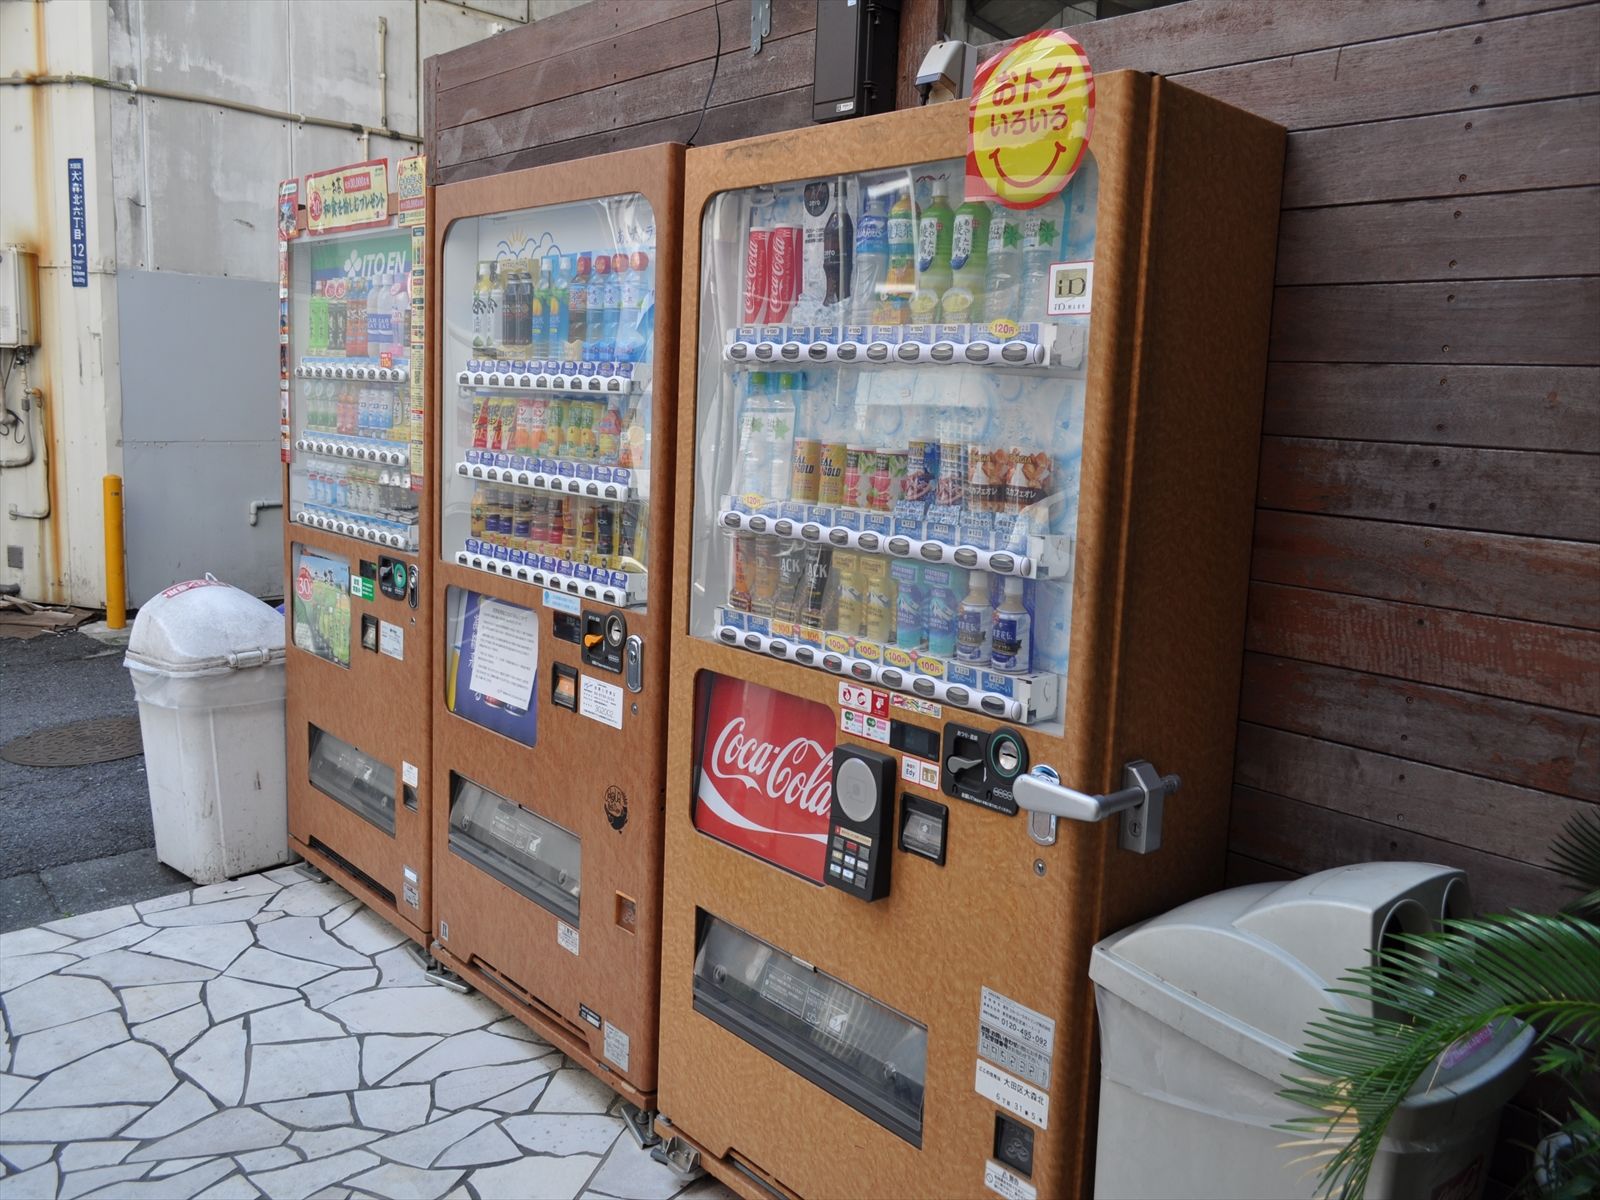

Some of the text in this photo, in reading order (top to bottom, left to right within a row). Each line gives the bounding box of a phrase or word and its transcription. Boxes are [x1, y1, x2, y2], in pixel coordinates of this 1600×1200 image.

[993, 63, 1072, 106] おトク
[990, 104, 1068, 137] いろいろ
[71, 170, 82, 240] 大森北六丁目
[73, 243, 85, 257] 12
[361, 250, 406, 279] ITO EN
[770, 235, 786, 314] Coca-Cola
[1056, 277, 1086, 296] iD
[712, 717, 832, 816] Coca-Cola
[1003, 1078, 1045, 1106] 大田区大森北
